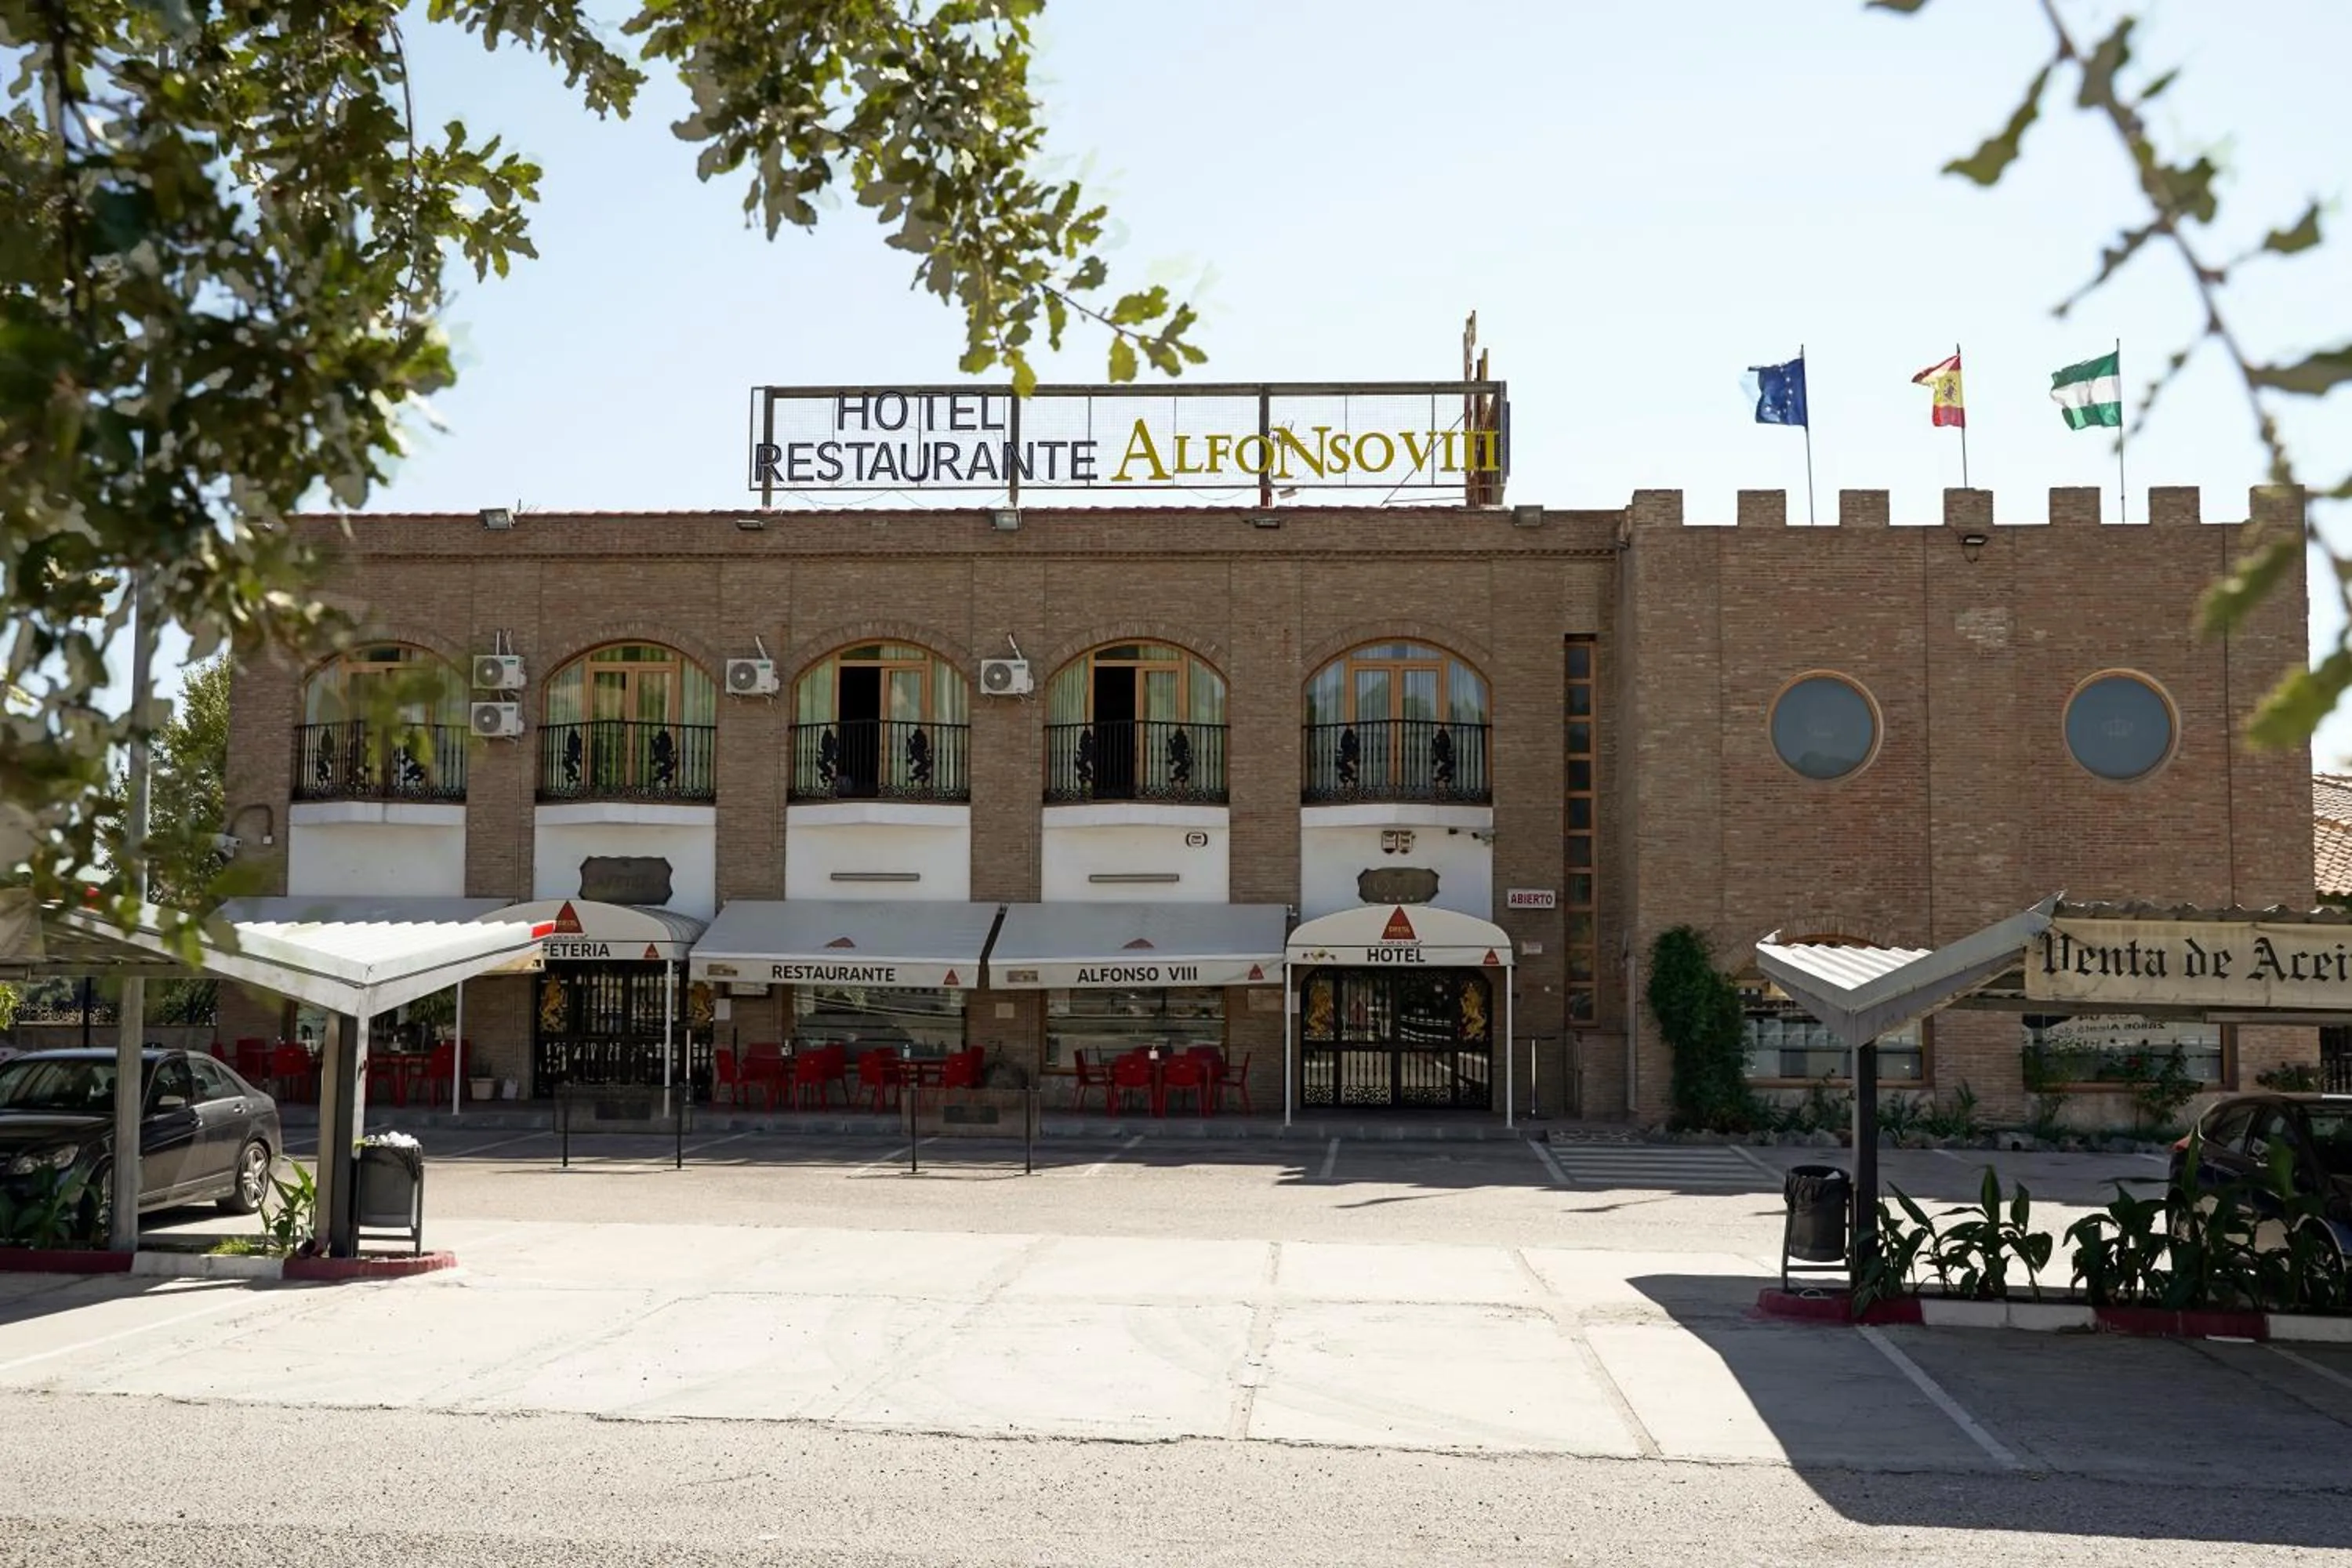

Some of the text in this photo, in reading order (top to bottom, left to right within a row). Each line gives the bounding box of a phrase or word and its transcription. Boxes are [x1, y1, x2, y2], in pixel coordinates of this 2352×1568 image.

[837, 392, 1004, 430] HOTEL
[755, 441, 1098, 481] RESTAURANTE
[1511, 893, 1553, 905] ABIERTO
[1367, 947, 1426, 963] HOTEL
[2035, 931, 2352, 982] Venta de Acei
[772, 965, 895, 982] RESTAURANTE
[1077, 966, 1198, 983] ALFONSO VIII
